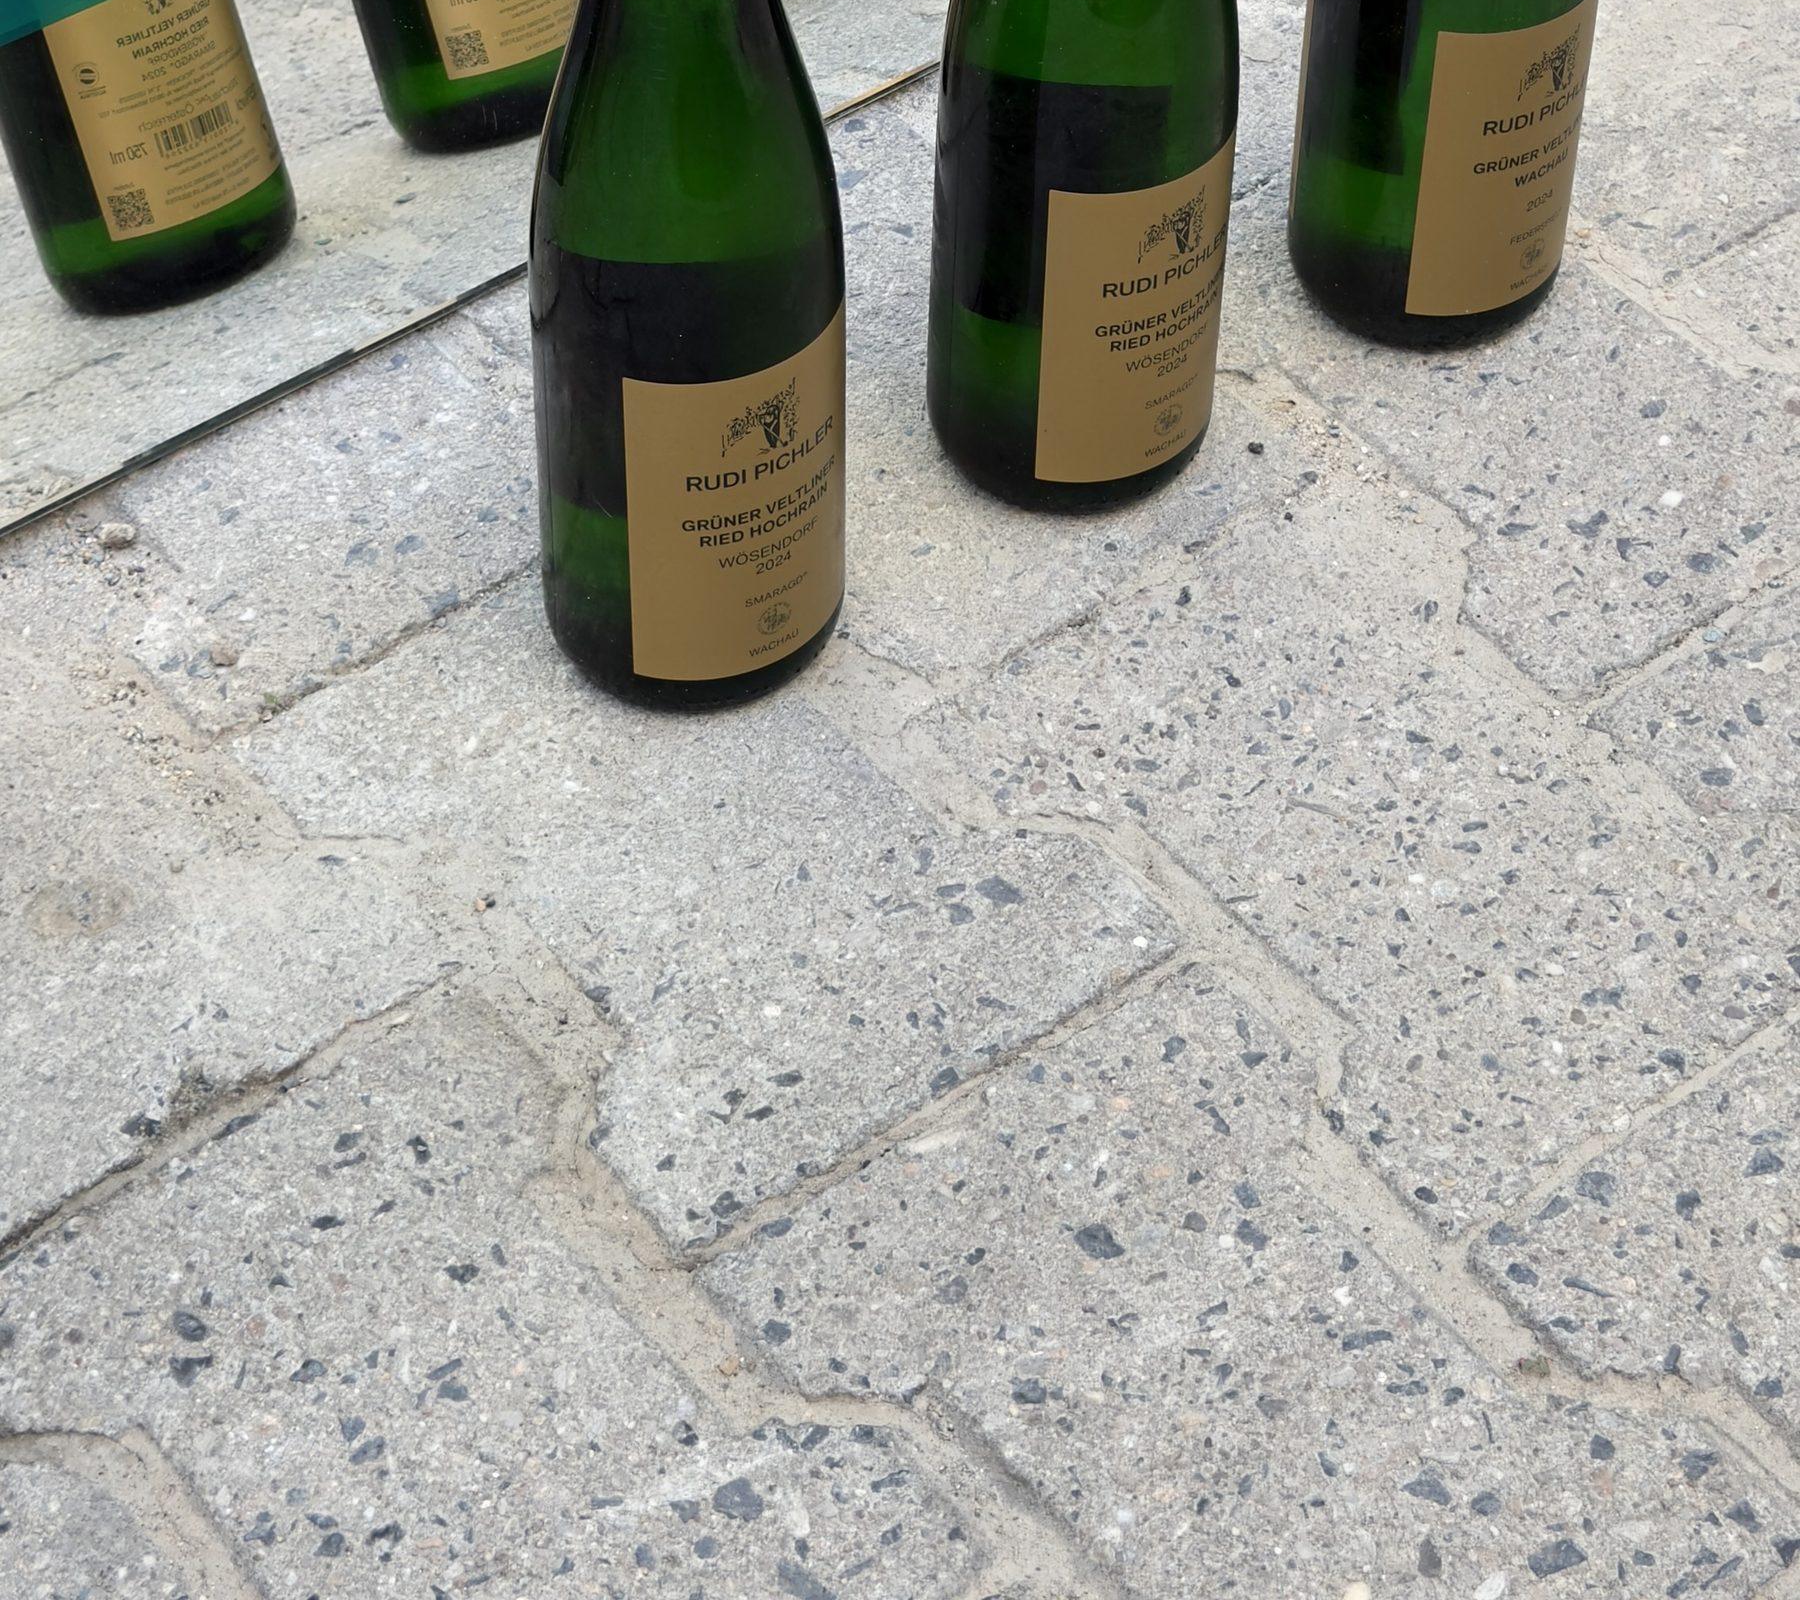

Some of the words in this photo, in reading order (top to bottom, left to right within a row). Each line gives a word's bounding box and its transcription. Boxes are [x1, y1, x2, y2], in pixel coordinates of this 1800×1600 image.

[1482, 111, 1535, 136] RUDI
[1473, 148, 1539, 175] GRÜNER
[1515, 147, 1569, 187] WACHAU
[1102, 274, 1158, 298] RUDI
[1095, 313, 1167, 338] GRÜNER
[1110, 335, 1150, 352] RIED
[1157, 354, 1188, 377] 2024
[685, 467, 747, 492] RUDI
[754, 415, 833, 480] PICHLER
[682, 509, 761, 532] GRÜNER
[766, 455, 835, 514] VELTLINER
[700, 529, 744, 548] RIED
[749, 483, 828, 539] HOCHRAIN
[718, 517, 819, 569] WÖSENDORF
[756, 550, 792, 575] 2024
[749, 628, 799, 657] WACHAU
